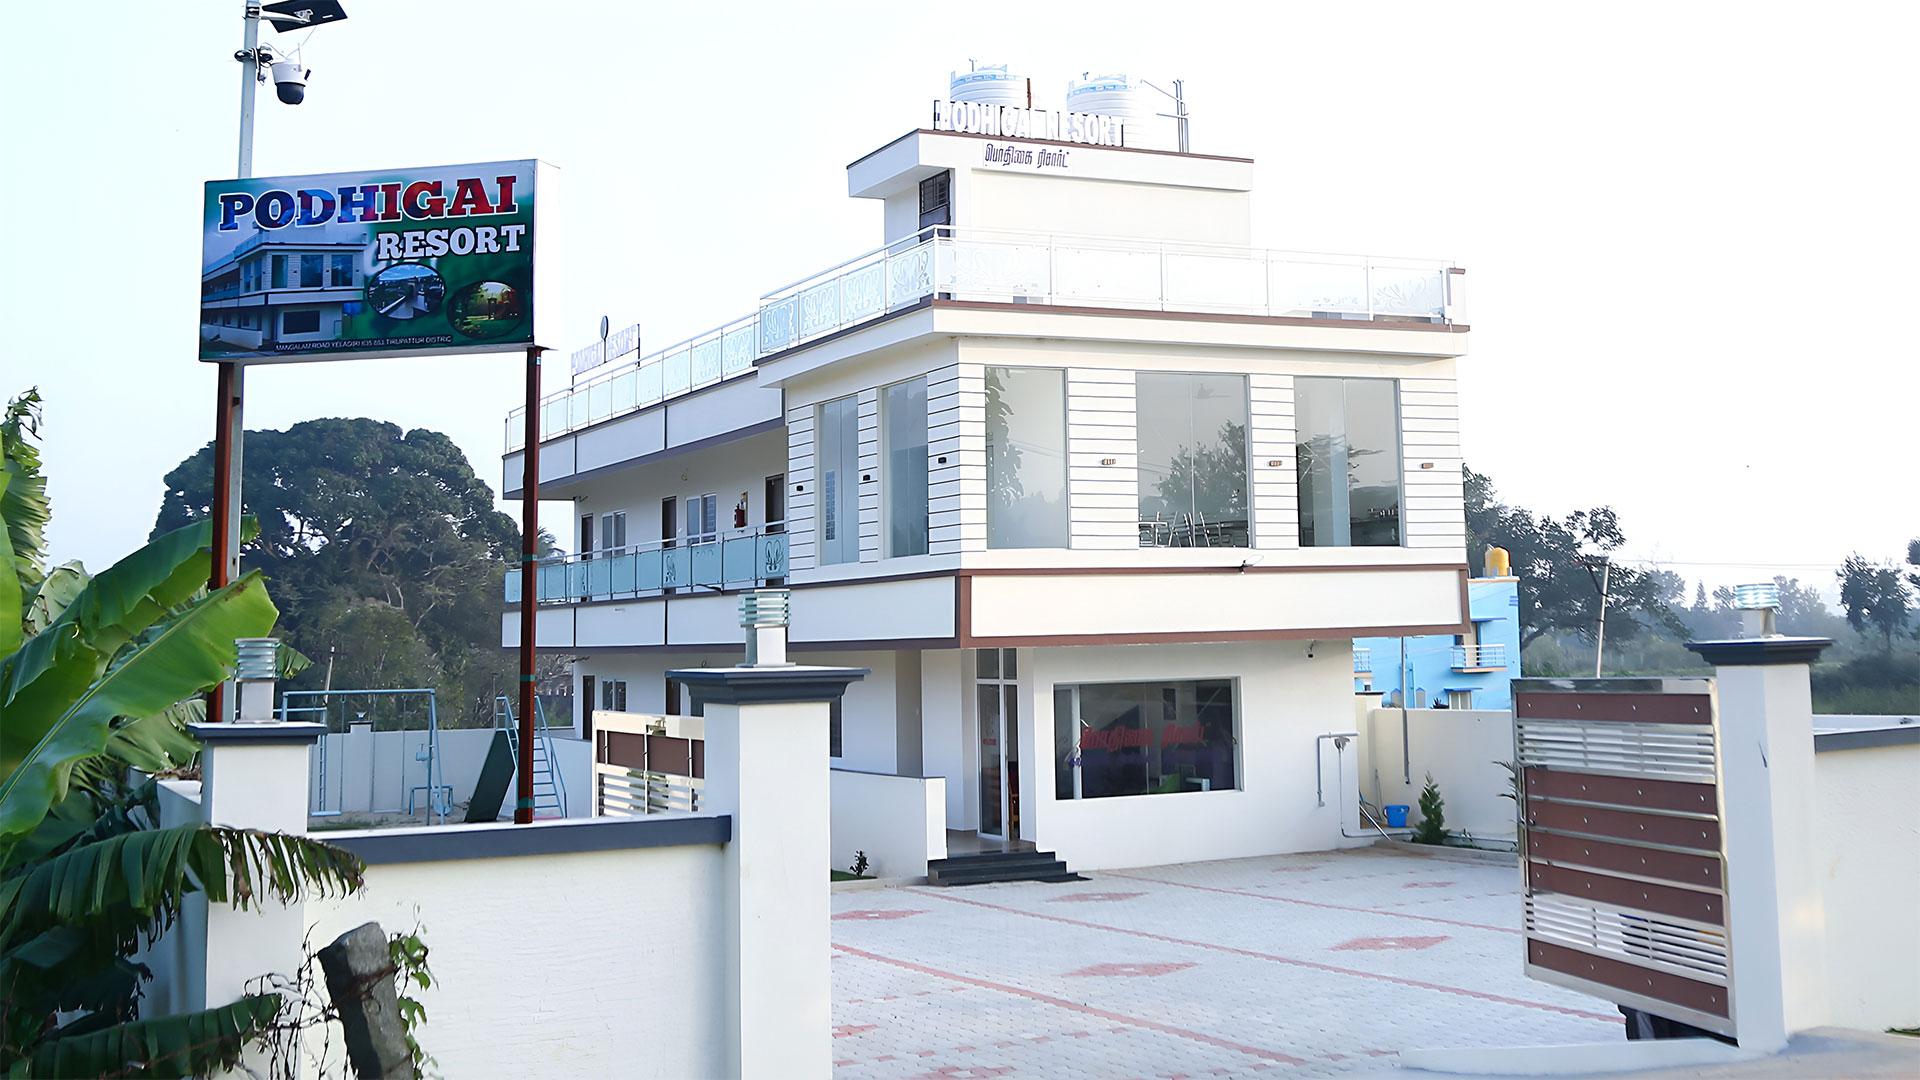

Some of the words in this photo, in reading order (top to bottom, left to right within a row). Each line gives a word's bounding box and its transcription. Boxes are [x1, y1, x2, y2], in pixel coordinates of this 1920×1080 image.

[984, 143, 1033, 167] பொதிகை
[218, 175, 519, 232] PODHIGAI
[376, 224, 527, 260] RESORT
[311, 340, 331, 349] ROAD
